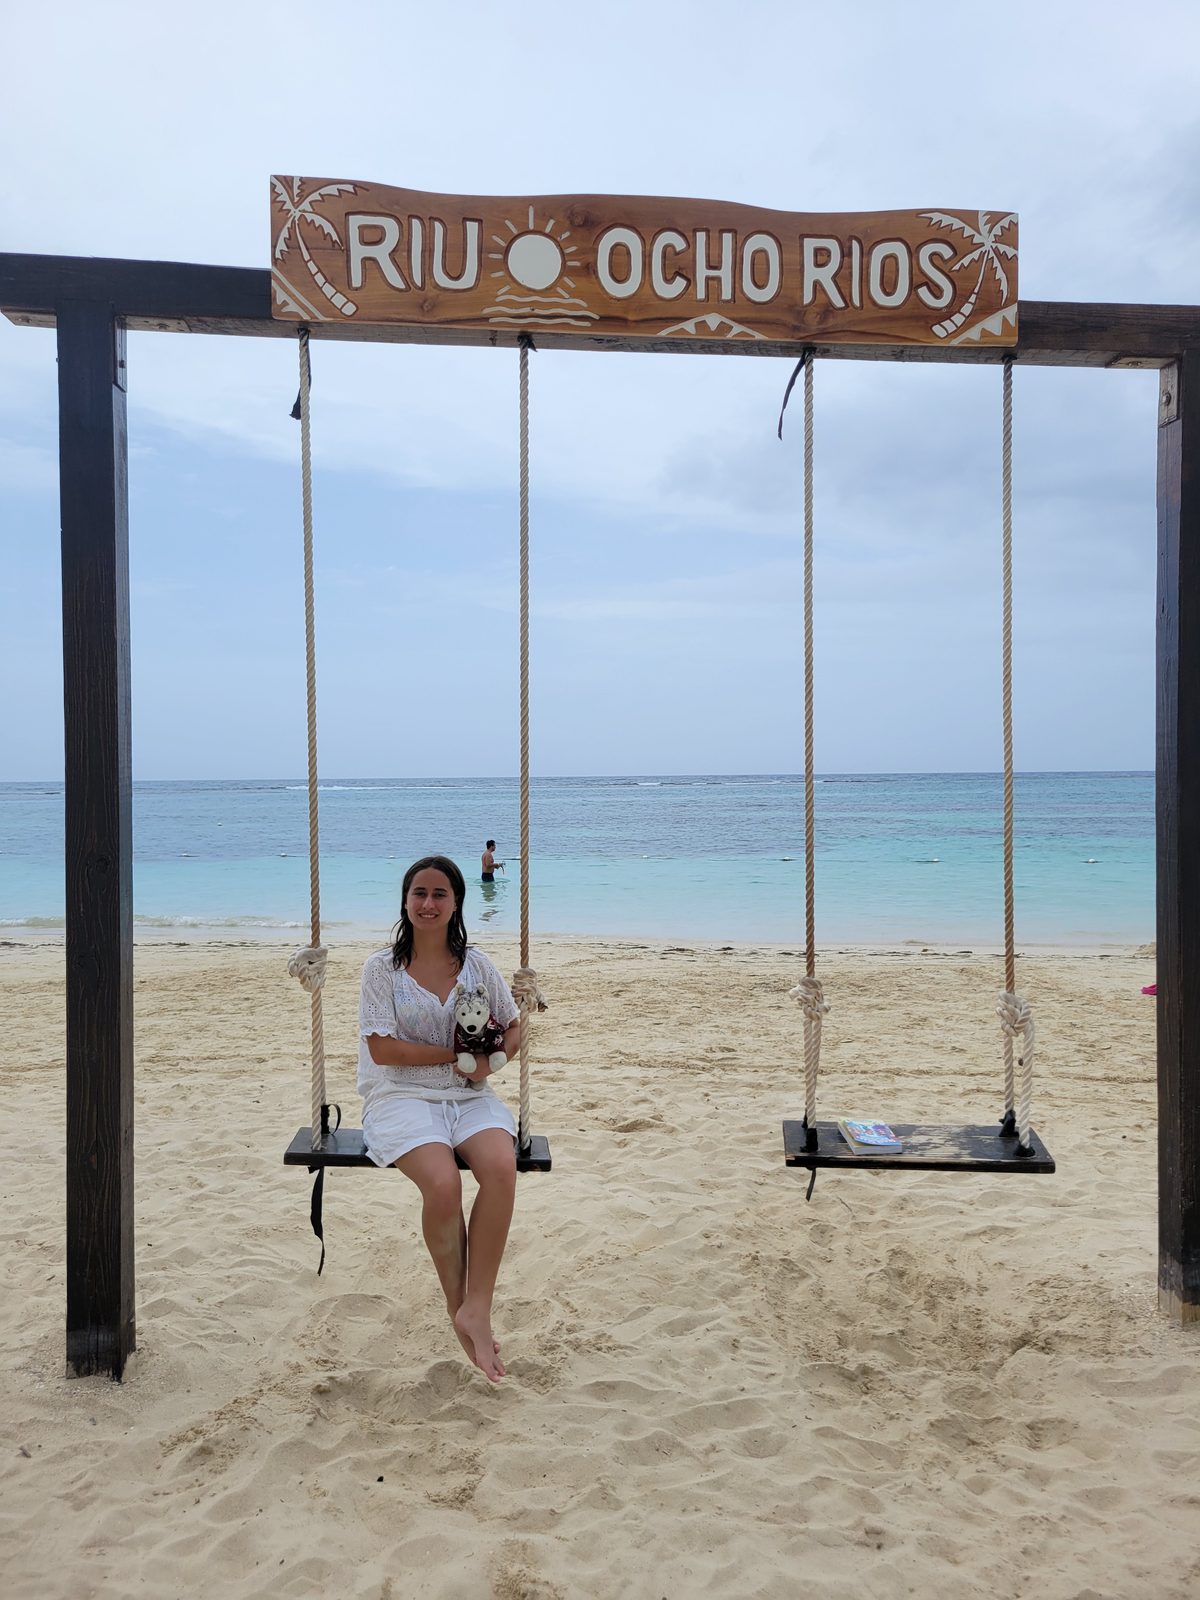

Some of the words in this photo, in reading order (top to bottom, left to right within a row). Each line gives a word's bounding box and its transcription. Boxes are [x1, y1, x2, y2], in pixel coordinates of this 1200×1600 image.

[348, 215, 479, 289] RIU
[597, 227, 780, 302] OCHO
[803, 238, 954, 308] RIOS
